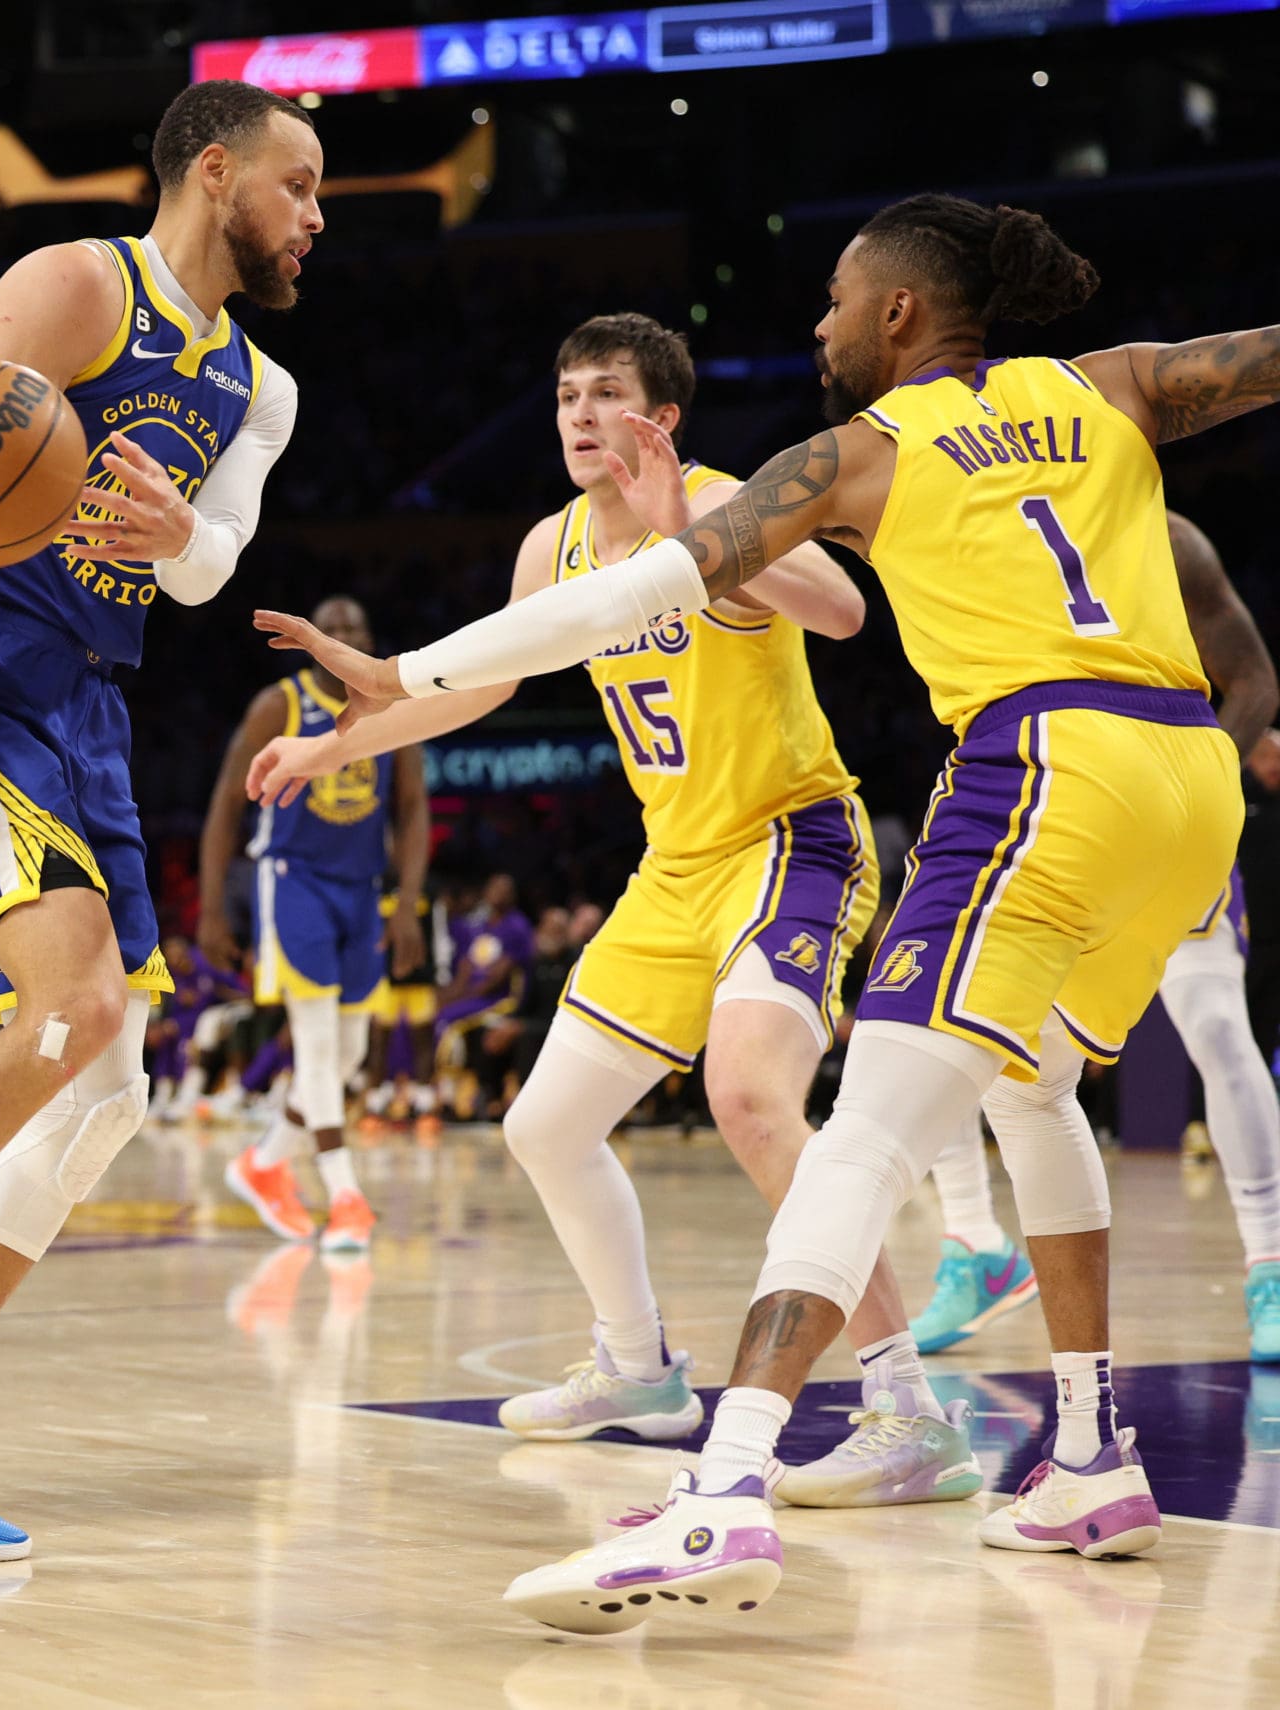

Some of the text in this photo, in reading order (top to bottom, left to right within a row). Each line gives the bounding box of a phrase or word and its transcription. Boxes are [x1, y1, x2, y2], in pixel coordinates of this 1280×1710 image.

[484, 24, 637, 70] DELTA
[136, 306, 151, 332] 6
[205, 364, 251, 400] Rakuten
[102, 392, 182, 424] GOLDEN
[932, 415, 1088, 477] RUSSELL
[1017, 494, 1121, 637] 1
[602, 676, 689, 775] 15
